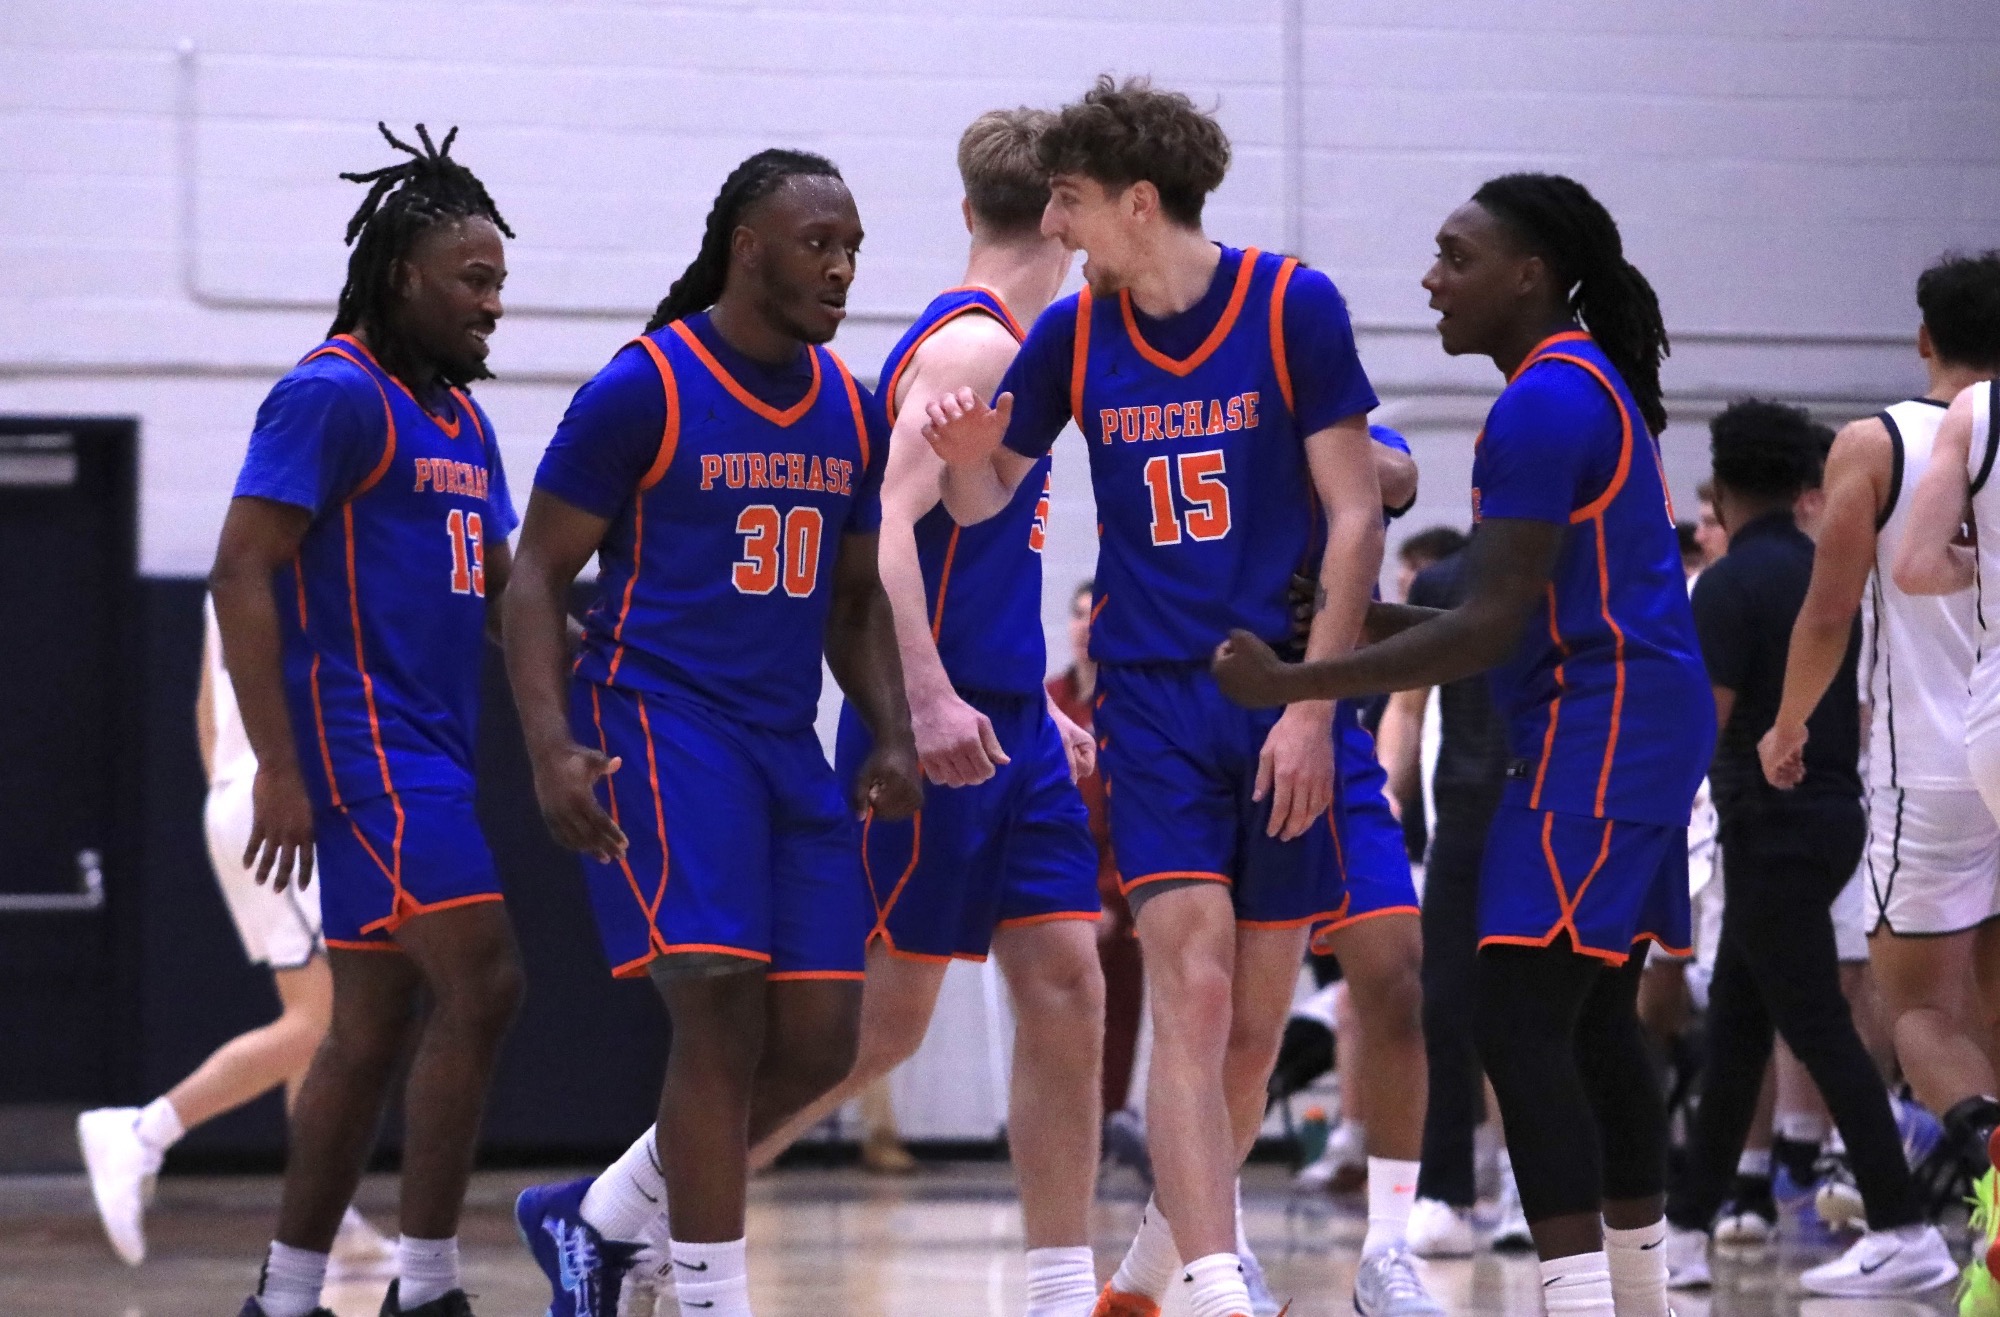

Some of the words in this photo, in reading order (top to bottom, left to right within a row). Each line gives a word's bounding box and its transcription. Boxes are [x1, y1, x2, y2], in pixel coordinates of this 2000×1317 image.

[1099, 391, 1259, 445] PURCHASE
[700, 452, 853, 495] PURCHASE
[1144, 449, 1231, 546] 15
[447, 509, 484, 597] 13
[732, 504, 824, 598] 30
